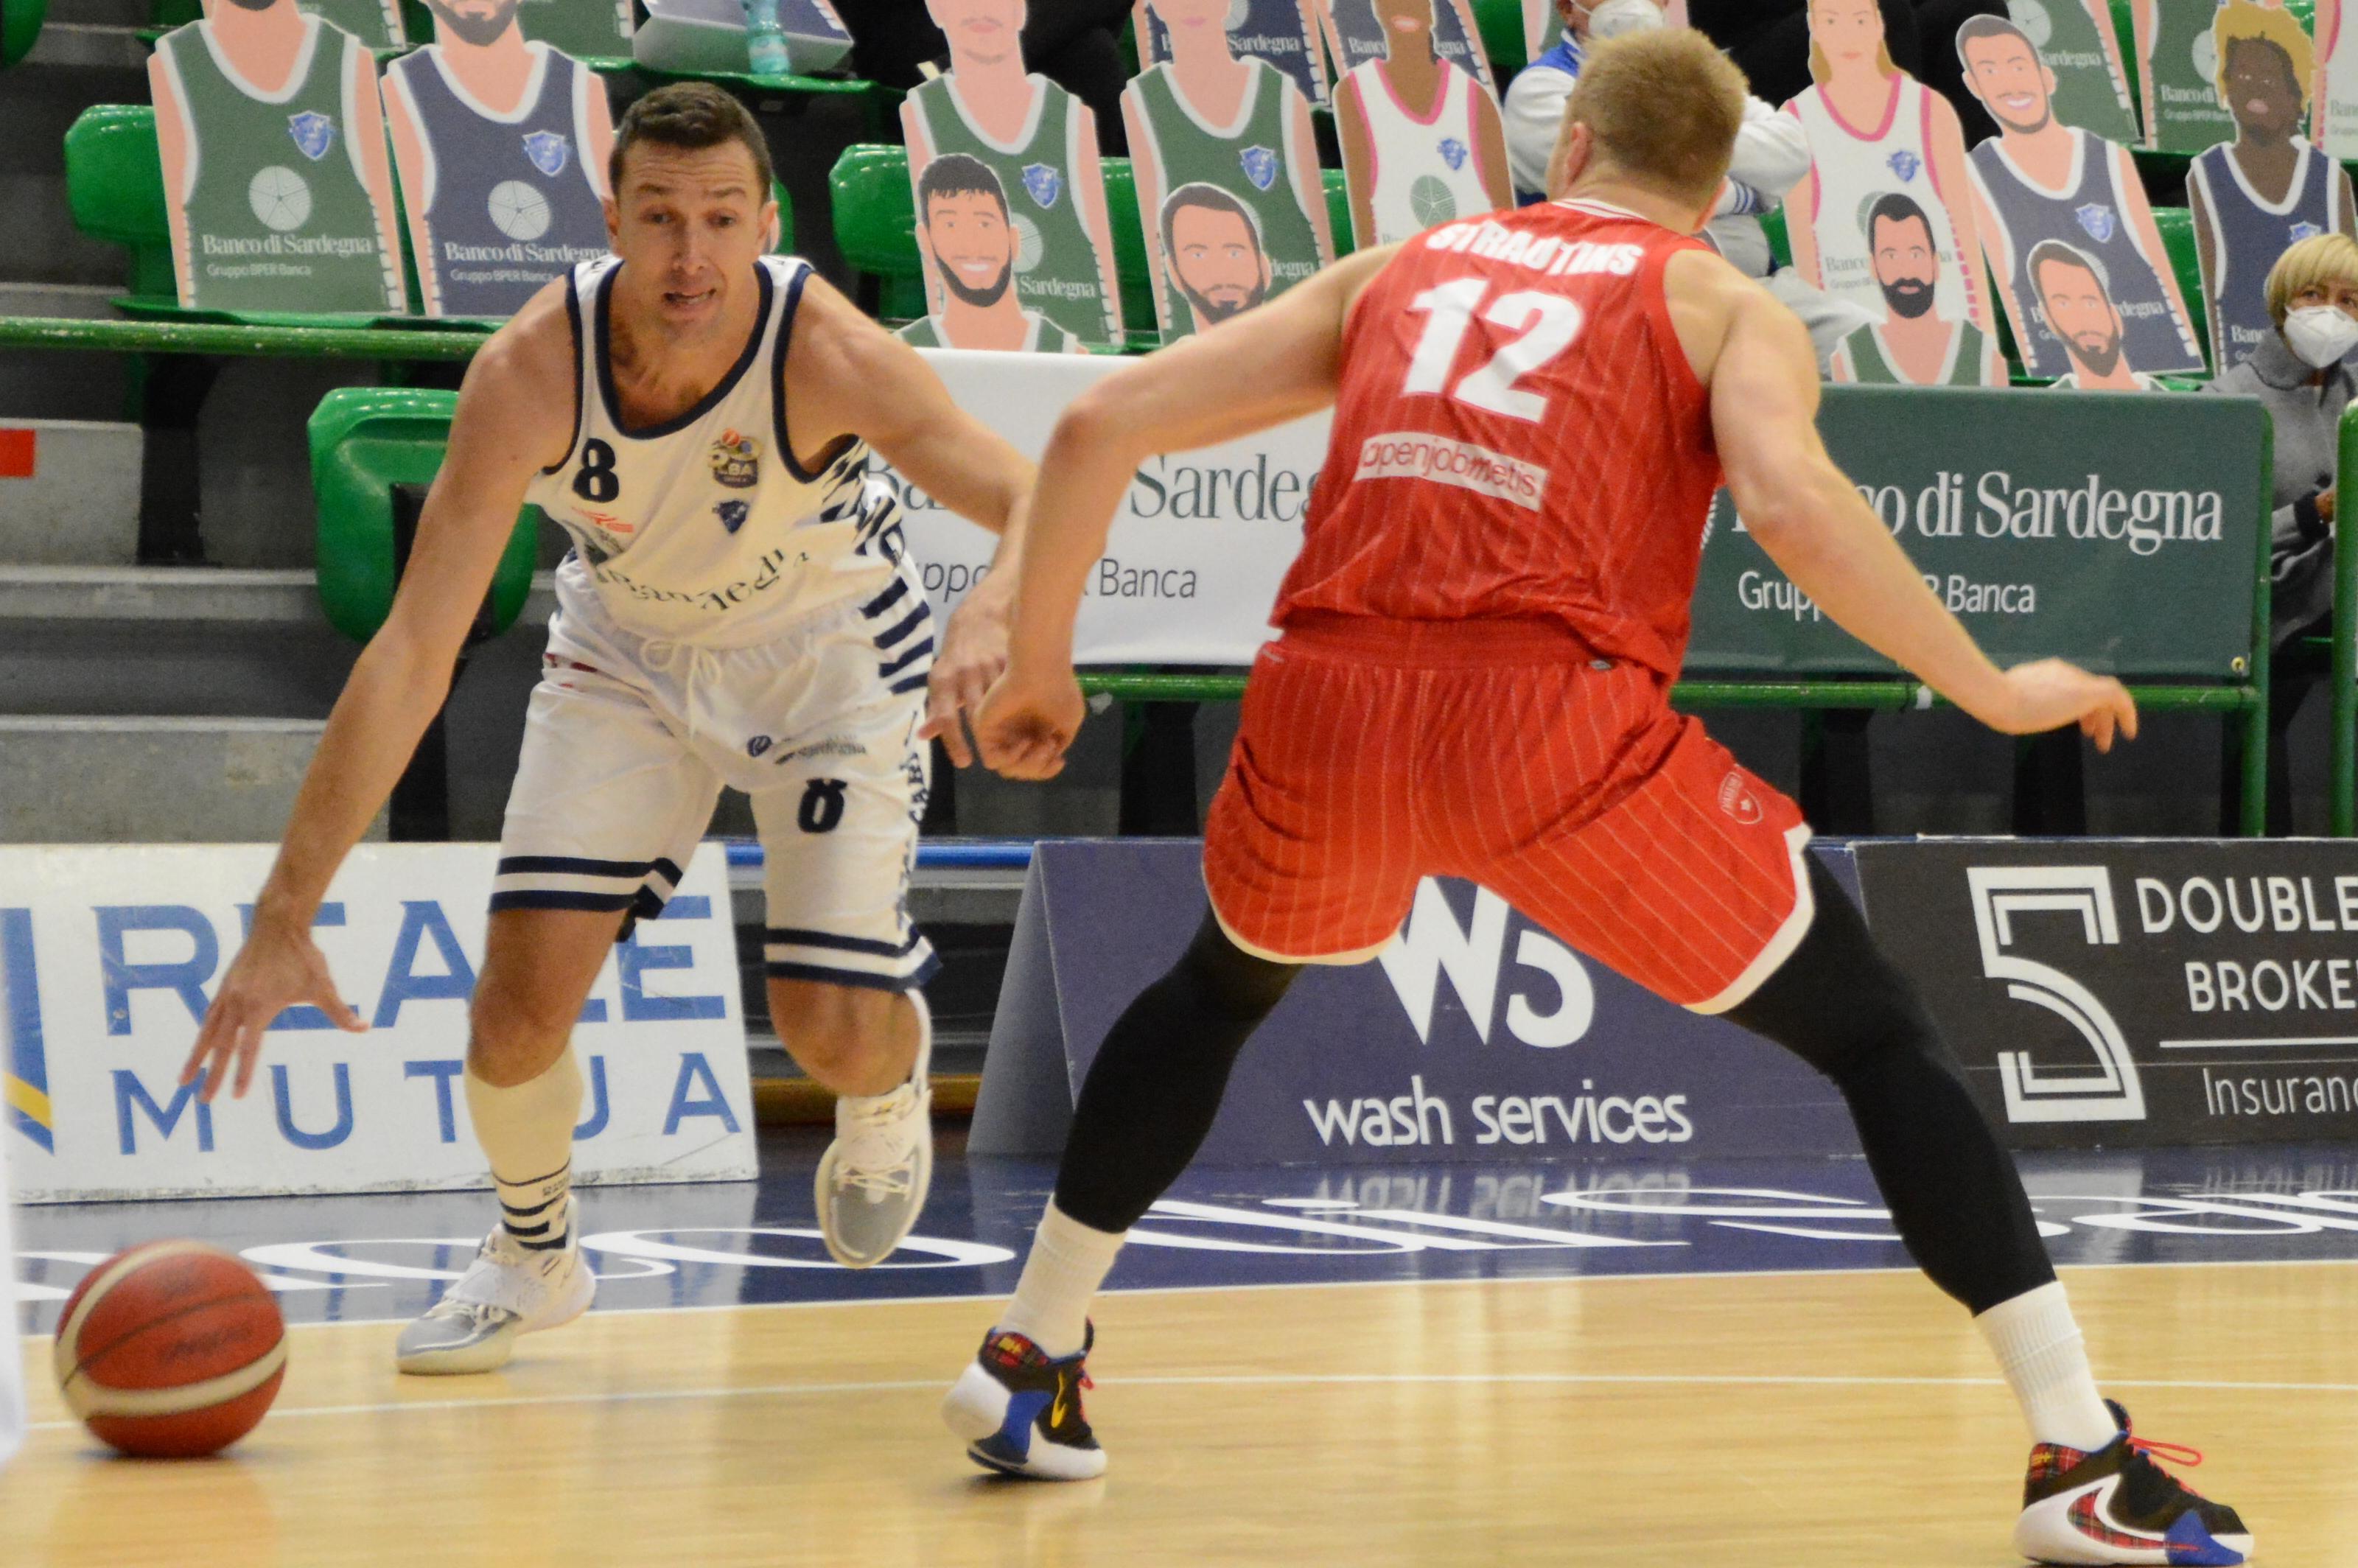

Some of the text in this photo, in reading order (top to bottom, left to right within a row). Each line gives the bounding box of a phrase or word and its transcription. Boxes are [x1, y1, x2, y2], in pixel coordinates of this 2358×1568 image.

[1228, 34, 1301, 56] Sardegna
[203, 234, 371, 259] Banco di Sardegna
[444, 241, 505, 260] Banco
[505, 243, 522, 262] di
[1426, 219, 1645, 276] STRAUTINS
[1825, 255, 1867, 272] Banc
[206, 263, 250, 278] Gruppo
[450, 268, 493, 284] Gruppo
[1019, 276, 1096, 301] Sardegna
[2118, 300, 2165, 318] degna
[1402, 277, 1582, 424] 12
[573, 438, 620, 504] 8
[1130, 453, 1322, 534] Sarde
[1916, 472, 1965, 538] di
[1975, 472, 2224, 556] Sardegna
[1098, 558, 1197, 598] Banca
[1945, 575, 2035, 614] Banca
[2135, 876, 2358, 934] DOUBLE
[90, 895, 727, 1037] RAE
[2185, 959, 2358, 1012] BROKE
[1303, 1074, 1693, 1147] wash services
